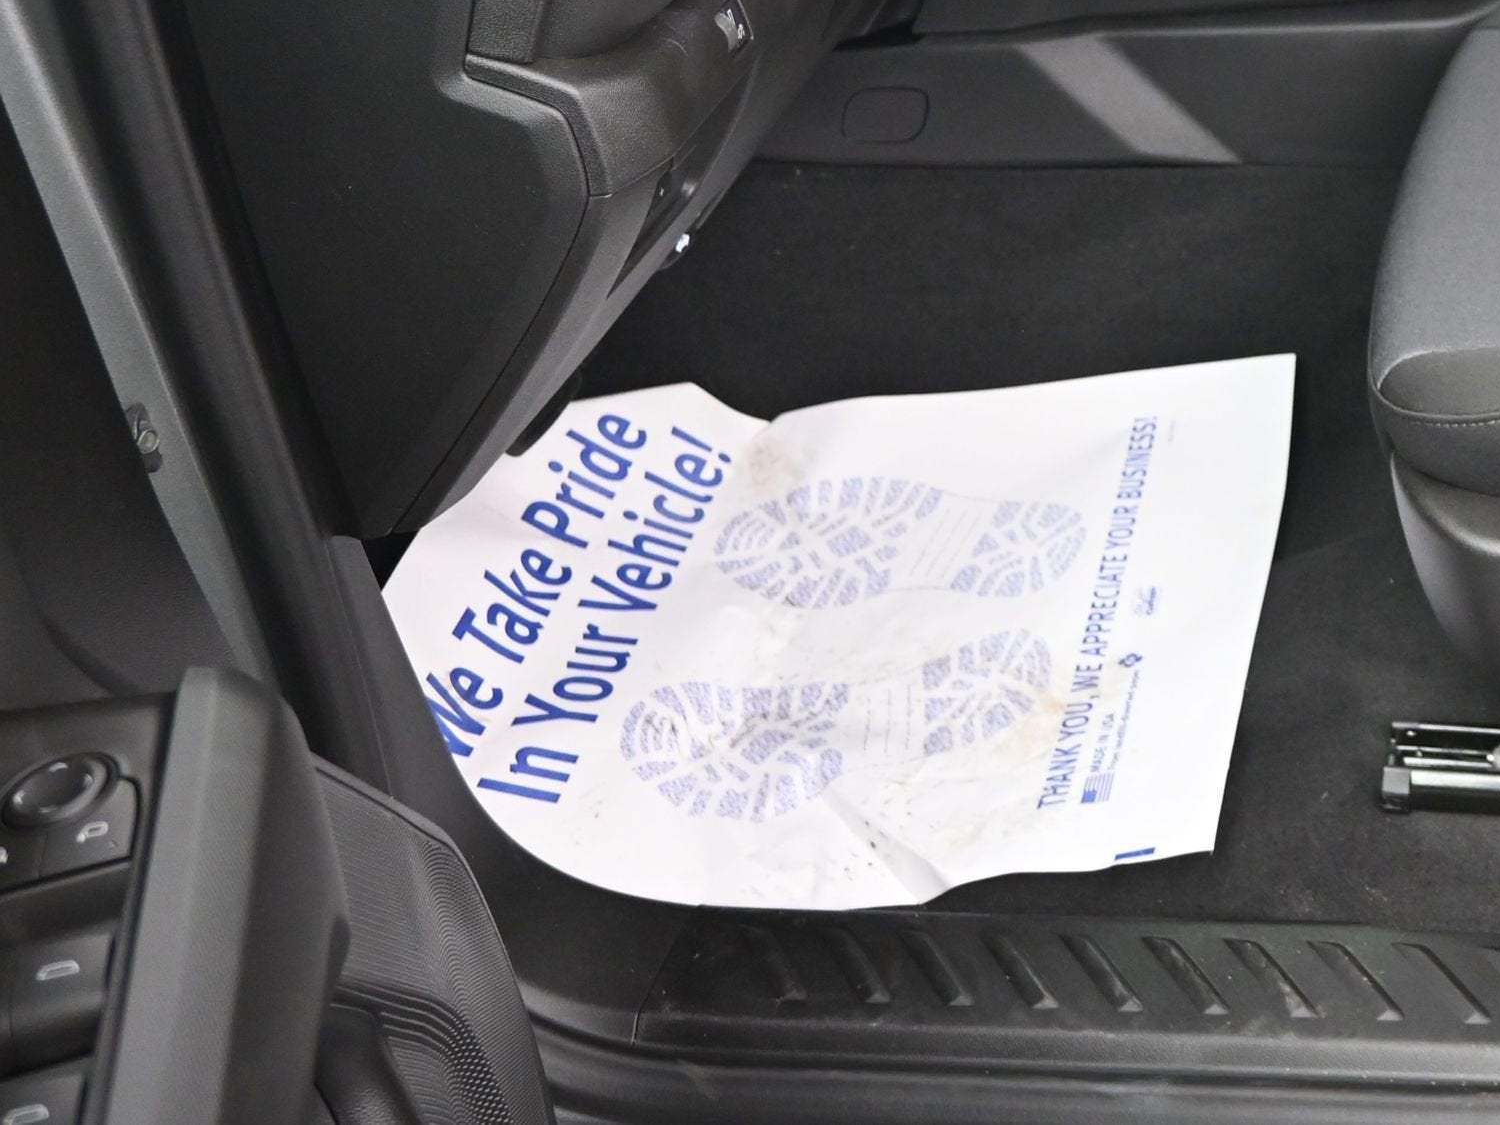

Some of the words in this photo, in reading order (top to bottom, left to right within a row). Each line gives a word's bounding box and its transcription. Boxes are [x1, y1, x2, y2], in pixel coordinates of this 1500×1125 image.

[521, 413, 647, 549] Pride
[1117, 415, 1158, 499] BUSINESS!
[578, 426, 732, 610] Vehicle!
[1105, 505, 1139, 550] YOUR
[452, 549, 573, 664] Take
[1080, 555, 1127, 657] APPRECIATE
[424, 666, 504, 757] We
[511, 624, 639, 725] Your
[1070, 663, 1103, 693] WE
[1057, 694, 1100, 743] YOU,
[1090, 747, 1107, 773] MADE
[1102, 712, 1115, 729] USA
[477, 745, 579, 804] In
[1037, 743, 1082, 810] THANK
